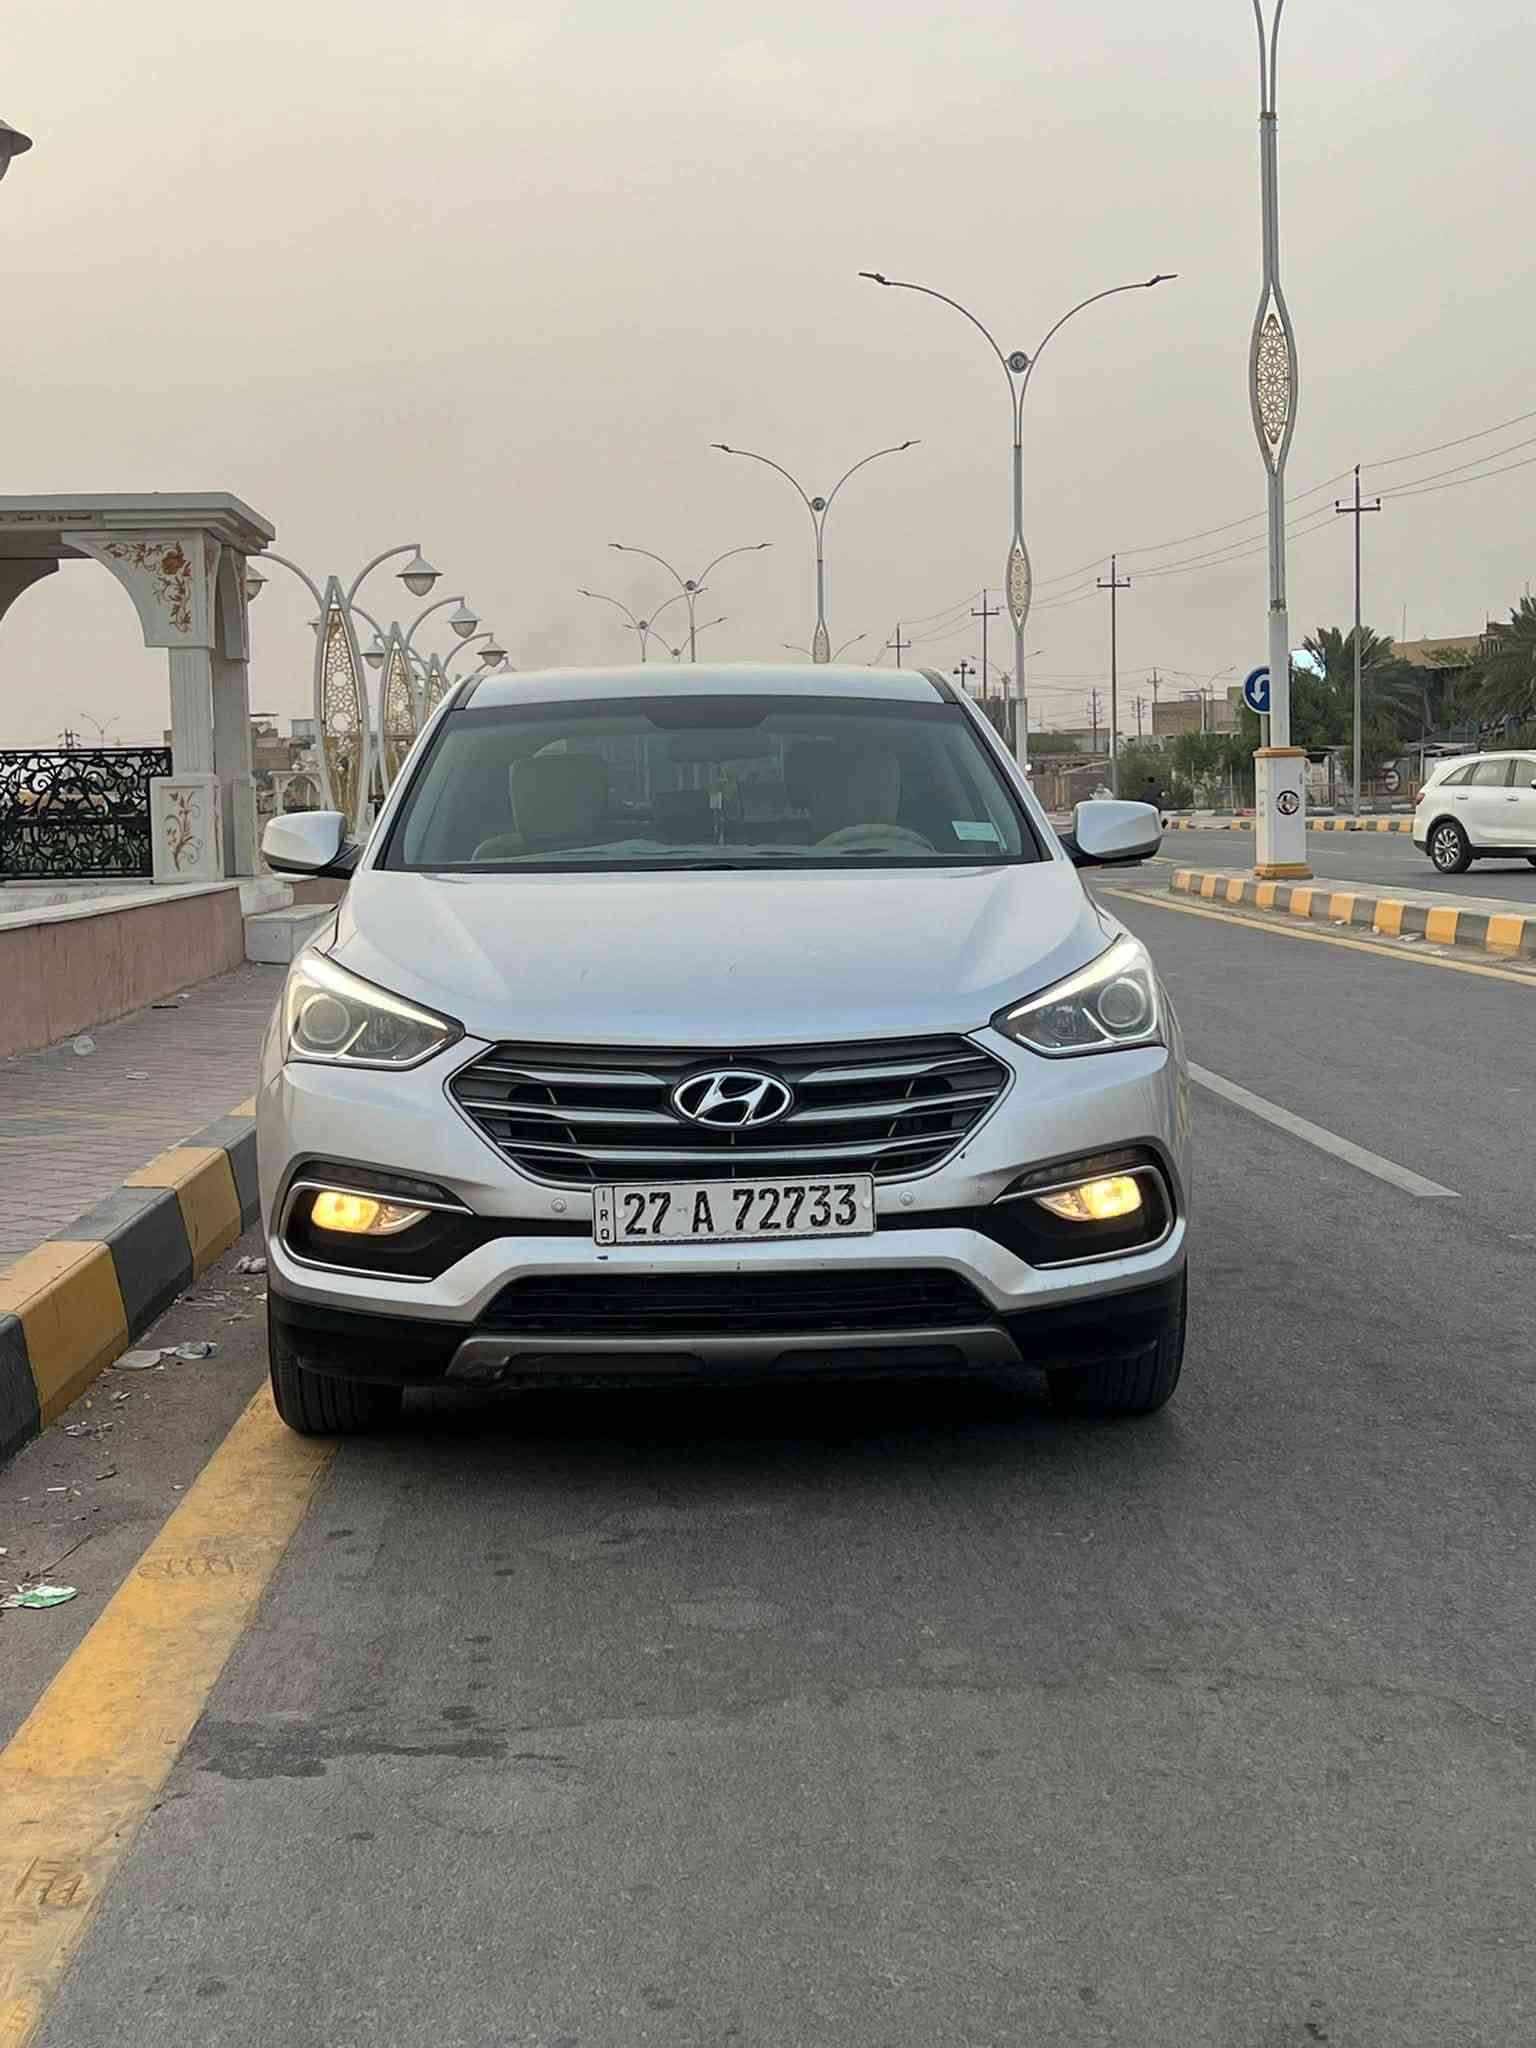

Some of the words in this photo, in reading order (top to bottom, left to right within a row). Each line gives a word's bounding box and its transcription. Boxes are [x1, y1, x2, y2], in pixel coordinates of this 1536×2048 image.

[623, 1192, 671, 1235] 27
[691, 1190, 715, 1233] A
[732, 1183, 857, 1232] 72733
